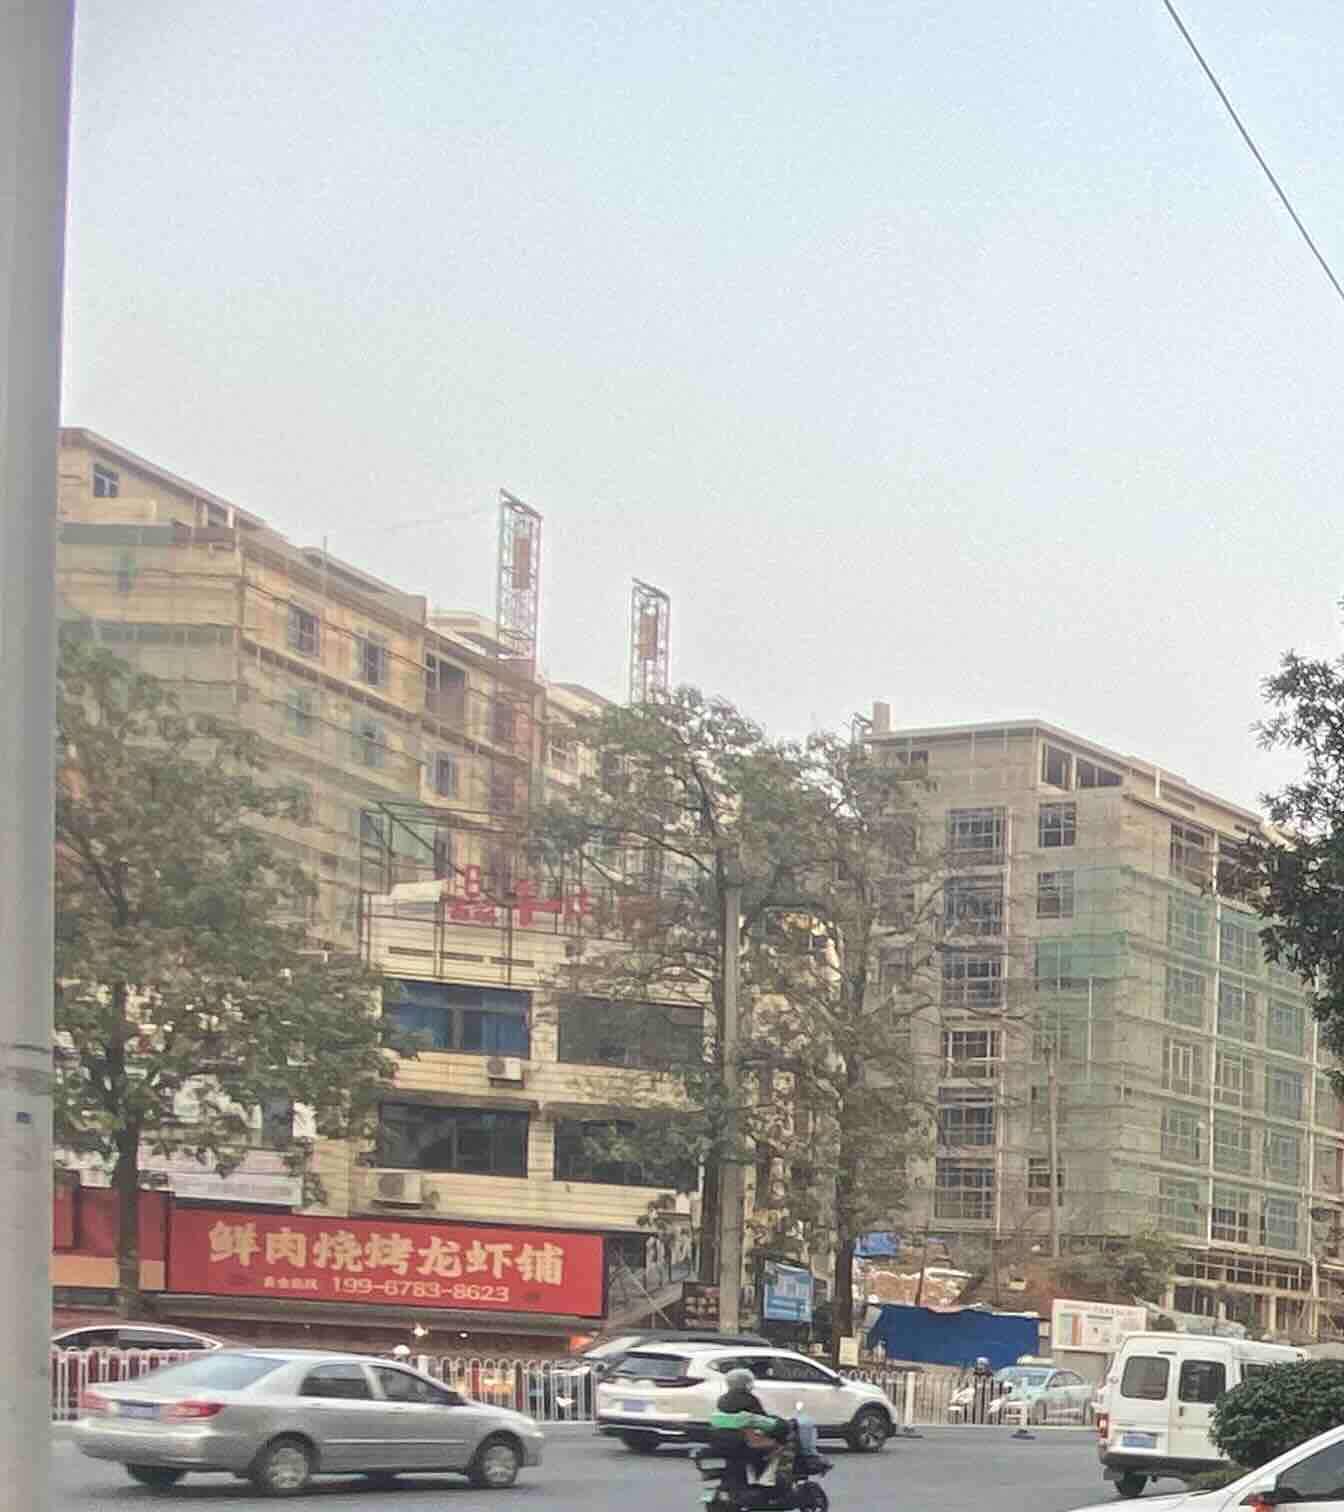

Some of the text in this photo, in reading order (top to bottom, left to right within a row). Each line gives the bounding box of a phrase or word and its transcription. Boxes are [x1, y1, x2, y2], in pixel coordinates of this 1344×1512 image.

[207, 1219, 566, 1286] 鲜肉烧烤龙虾铺
